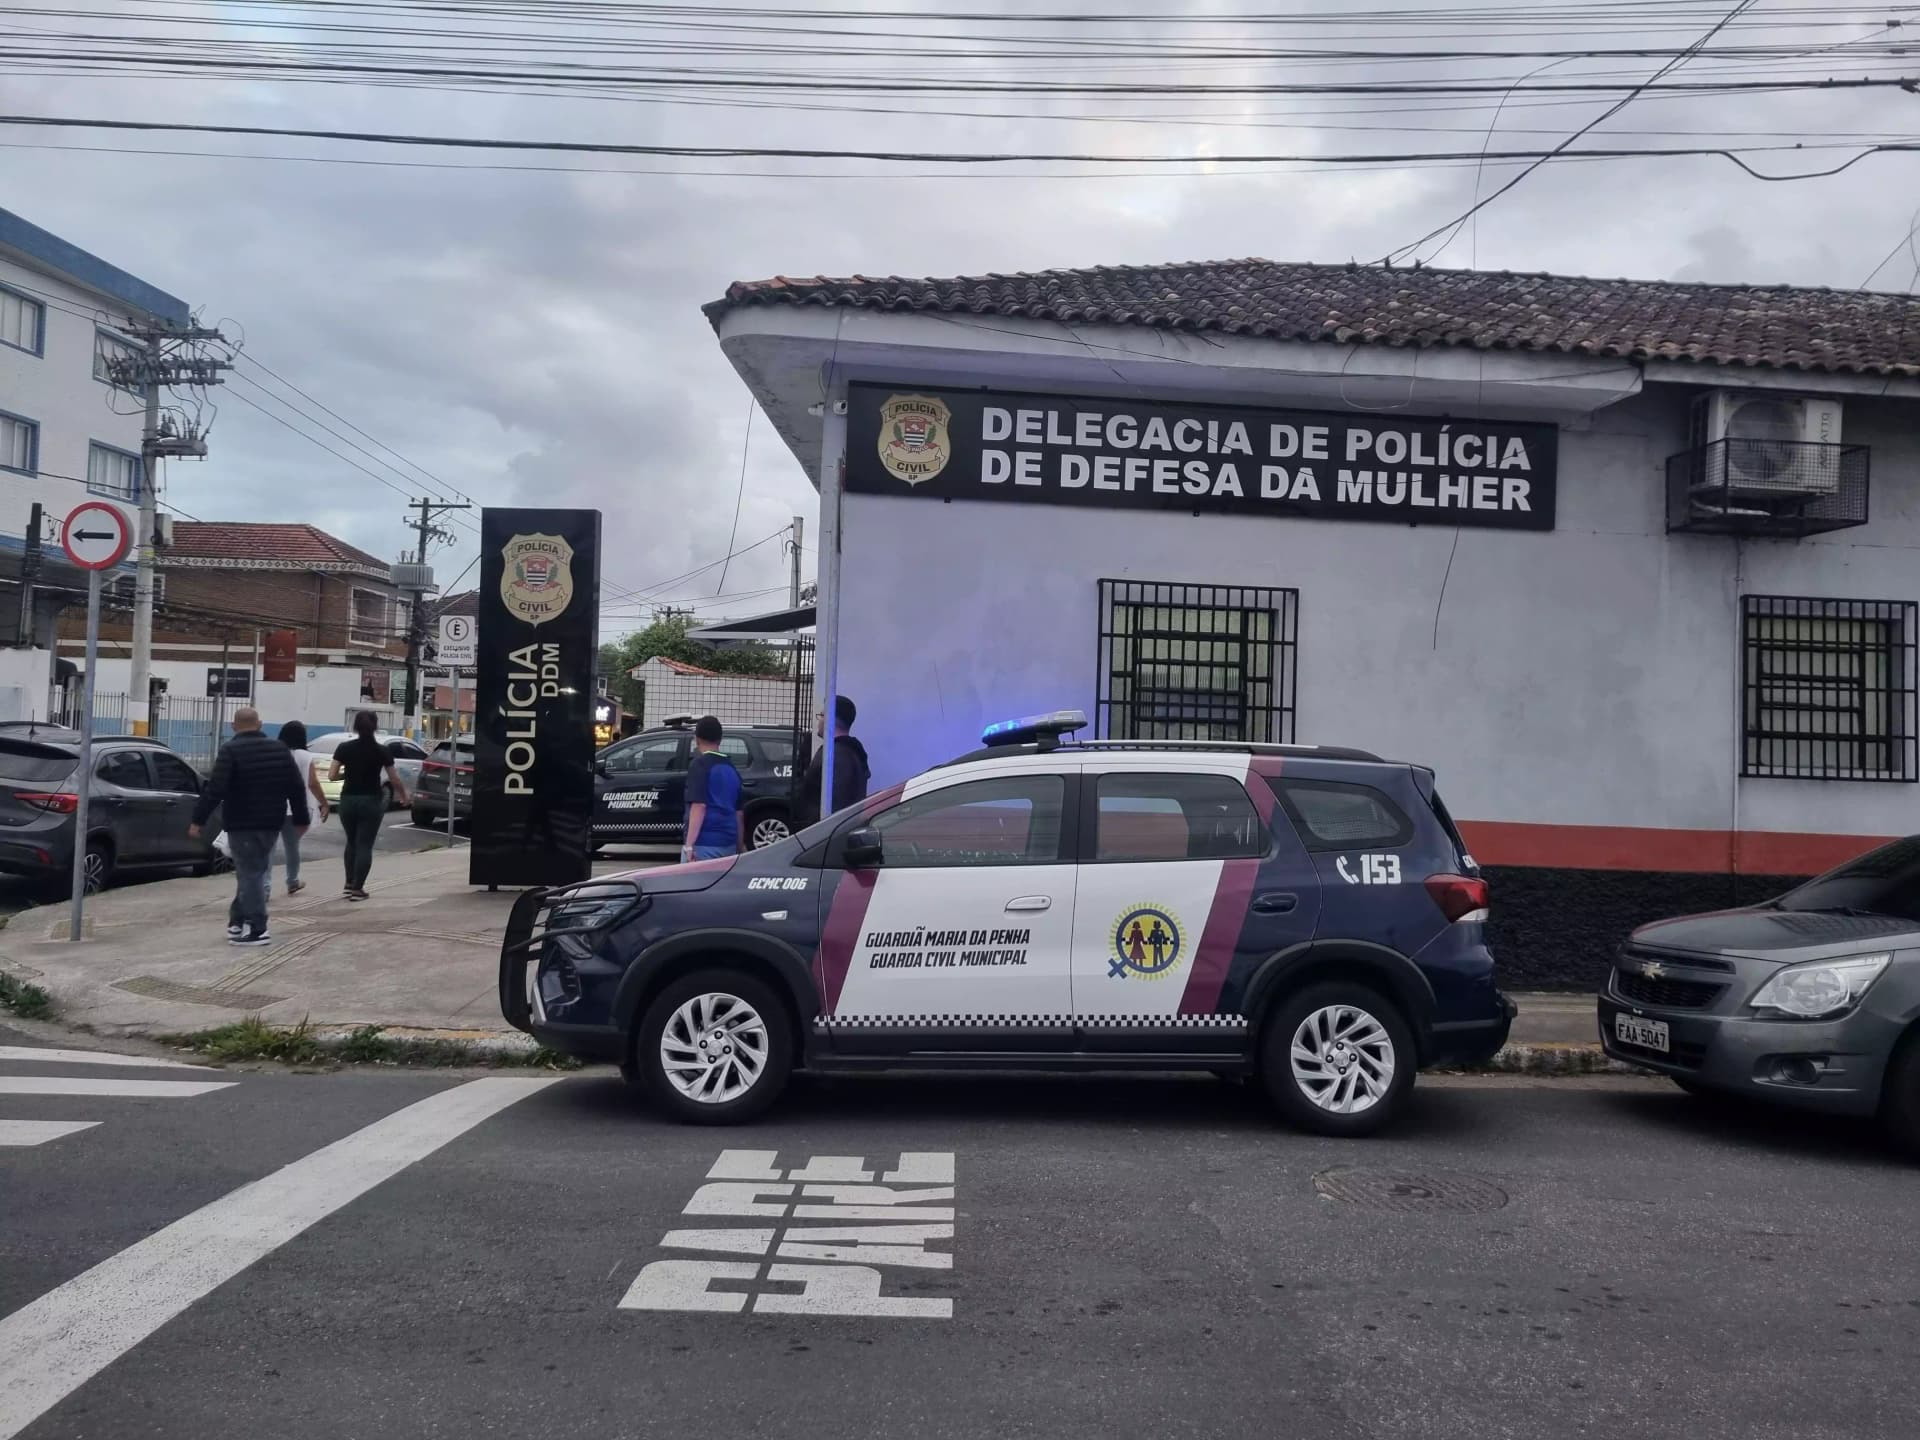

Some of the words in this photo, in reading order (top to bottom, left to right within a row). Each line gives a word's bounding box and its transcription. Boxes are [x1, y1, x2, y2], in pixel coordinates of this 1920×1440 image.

[896, 403, 936, 416] POLÍCIA
[982, 406, 1253, 456] DELEGACIA
[1270, 424, 1329, 460] DE
[1346, 424, 1532, 471] POLÍCIA
[896, 462, 930, 473] CIVIL
[981, 449, 1043, 486] DE
[1060, 454, 1245, 497] DEFESA
[1260, 465, 1321, 501] DA
[1336, 469, 1532, 512] MULHER
[517, 542, 559, 555] POLÍCIA
[518, 602, 552, 612] CIVIL
[541, 643, 560, 697] DDM
[498, 643, 539, 795] POLÍCIA
[607, 800, 653, 809] MUNICIPAL
[1360, 854, 1401, 884] 153
[782, 877, 808, 889] 006
[865, 926, 926, 948] GUARDIÃ
[924, 929, 967, 947] MARIA
[968, 930, 987, 946] DA
[989, 928, 1031, 945] PENHA
[869, 951, 923, 969] GUARDA
[924, 951, 957, 967] CIVIL
[959, 949, 1027, 966] MUNICIPAL
[616, 1149, 956, 1318] PARE
